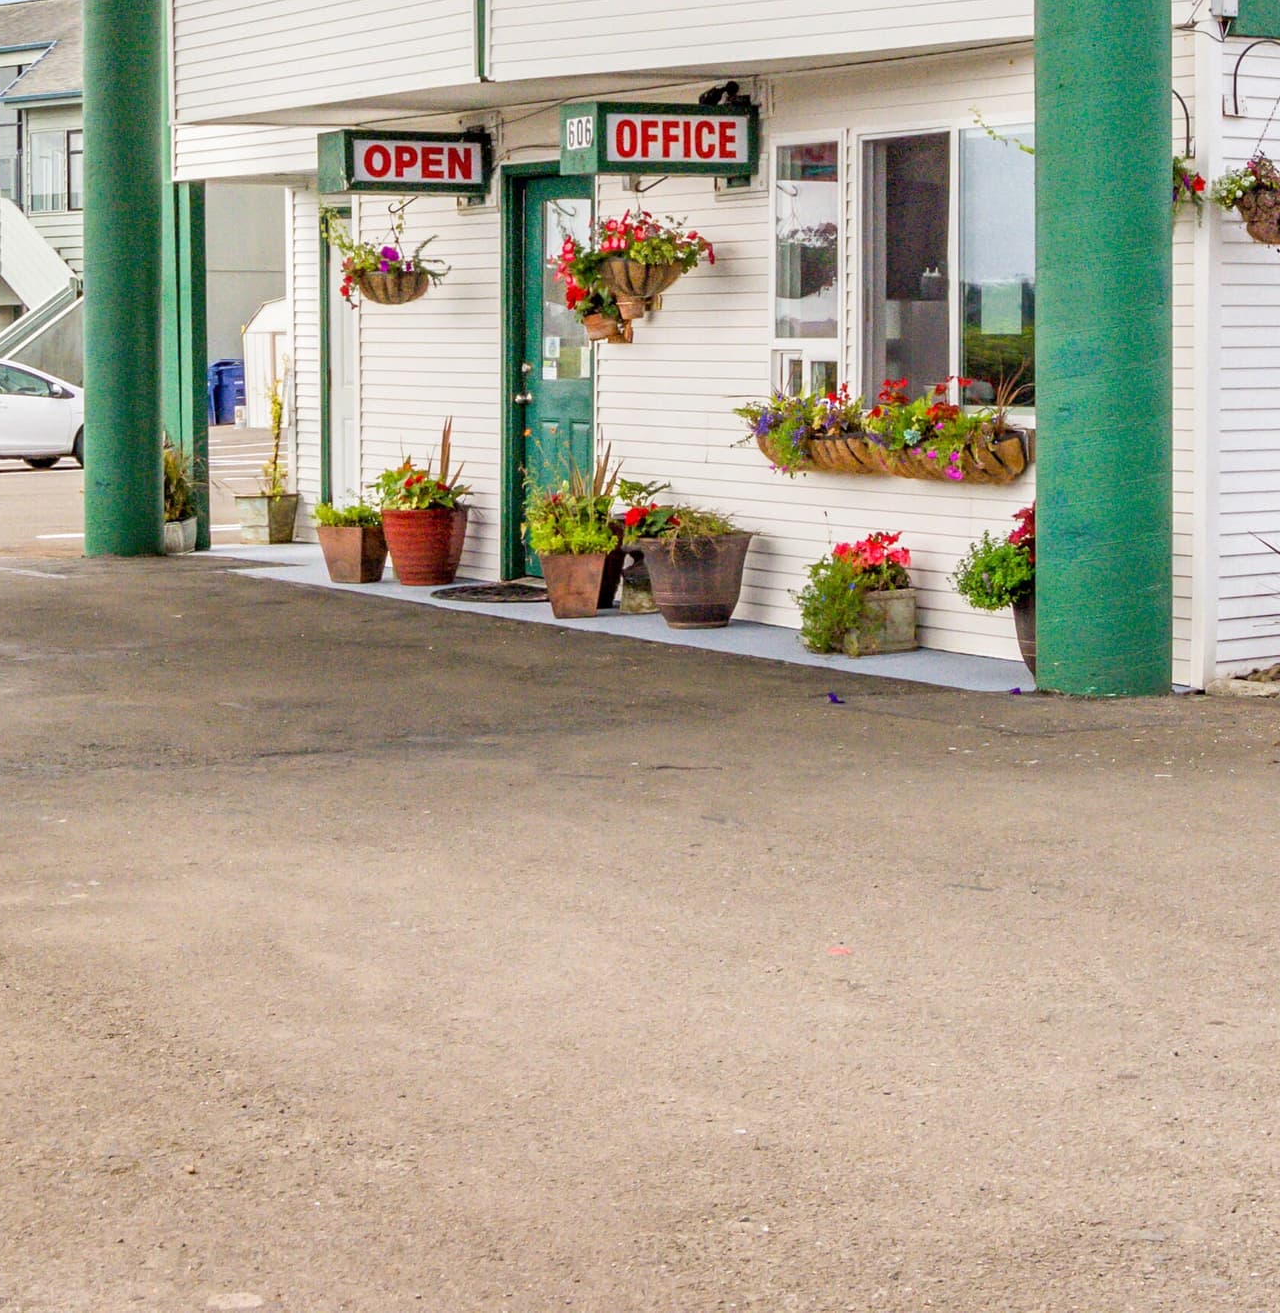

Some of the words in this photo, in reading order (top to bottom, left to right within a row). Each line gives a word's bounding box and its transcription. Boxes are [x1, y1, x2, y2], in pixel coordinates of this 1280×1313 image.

[568, 118, 592, 148] 606
[615, 119, 737, 159] OFFICE
[363, 144, 473, 180] OPEN
